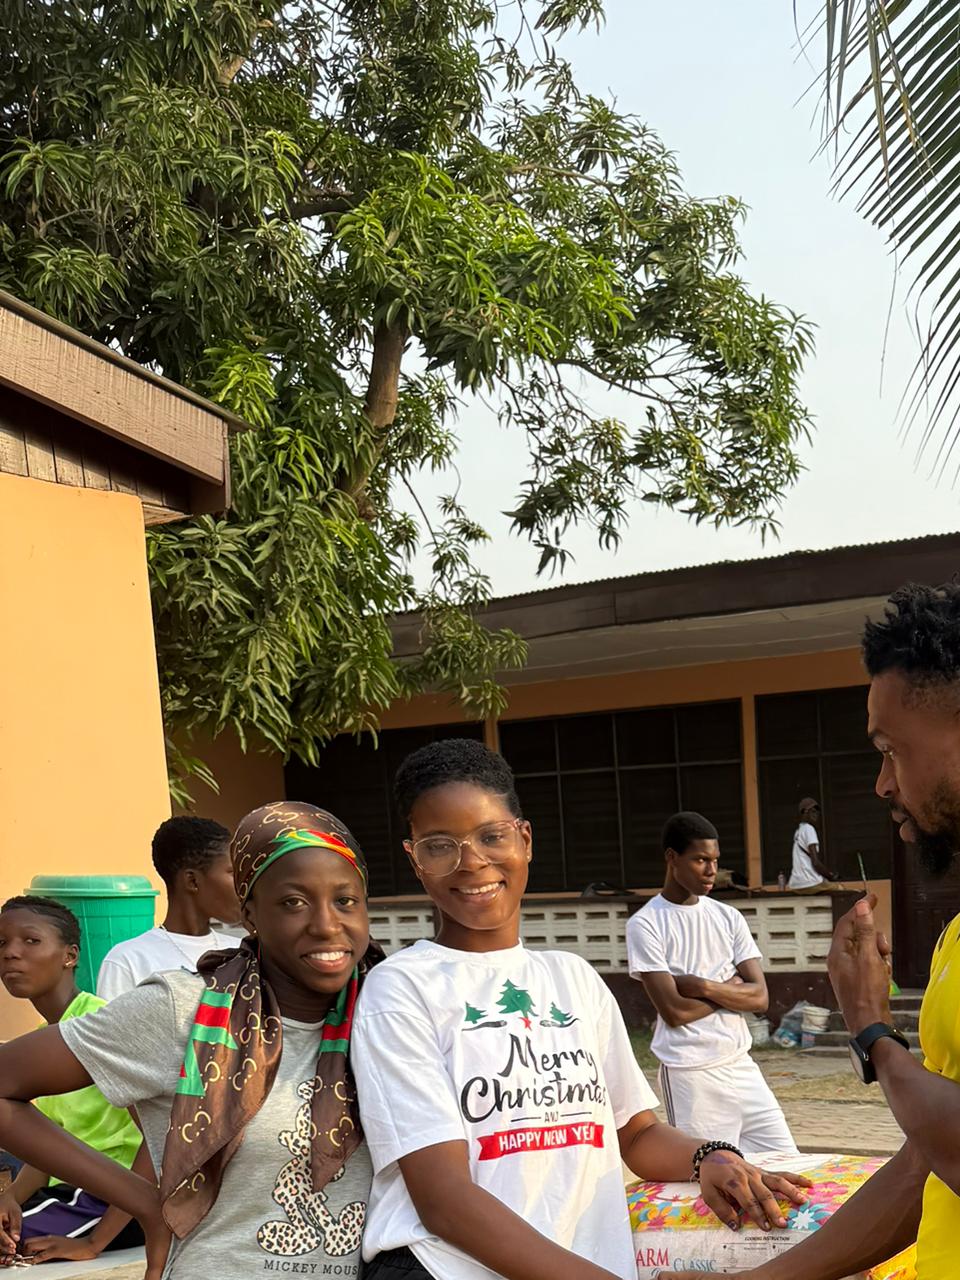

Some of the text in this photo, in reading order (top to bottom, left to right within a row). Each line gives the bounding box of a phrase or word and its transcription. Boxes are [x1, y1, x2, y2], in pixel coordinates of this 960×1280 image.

[497, 1033, 599, 1086] Merry
[498, 1125, 594, 1151] HAPPY NEW YE
[264, 1259, 359, 1275] MICKEY MOUS
[635, 1247, 669, 1267] ARM
